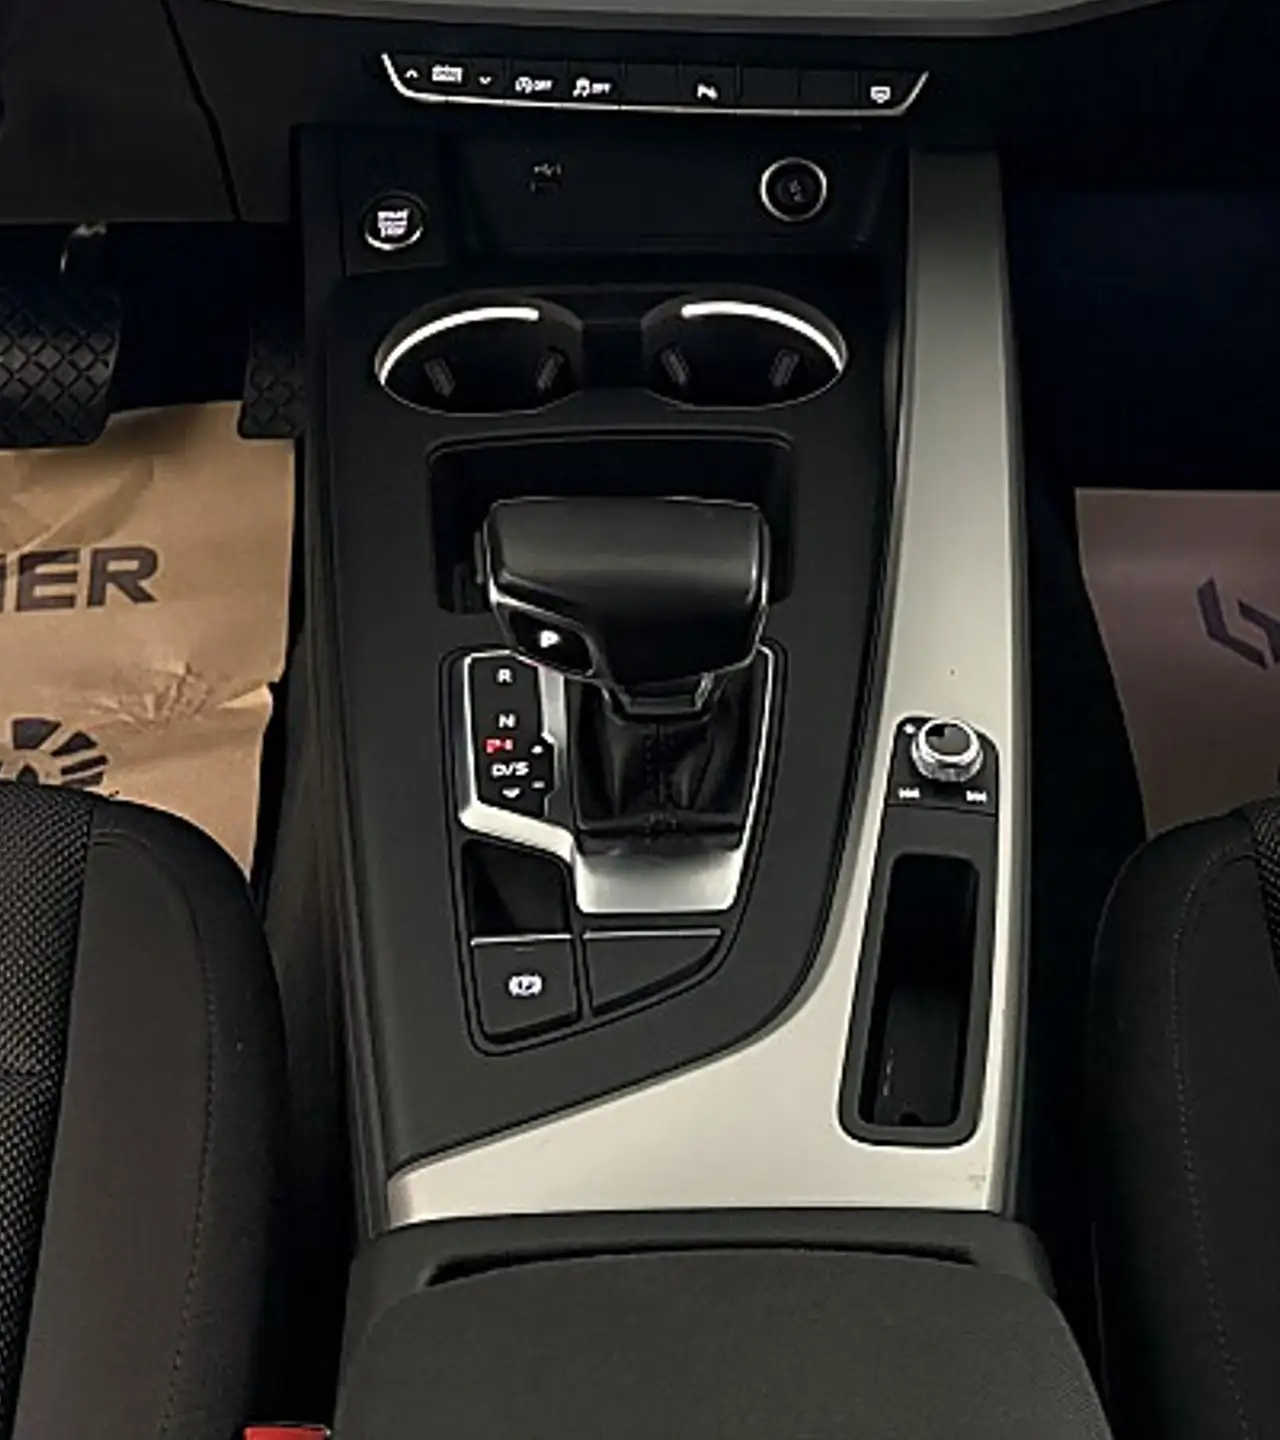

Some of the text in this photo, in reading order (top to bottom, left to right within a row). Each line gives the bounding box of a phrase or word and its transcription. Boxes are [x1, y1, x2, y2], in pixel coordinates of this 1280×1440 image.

[540, 629, 561, 649] P
[496, 668, 513, 684] R
[498, 713, 516, 729] N
[491, 761, 530, 778] D/S
